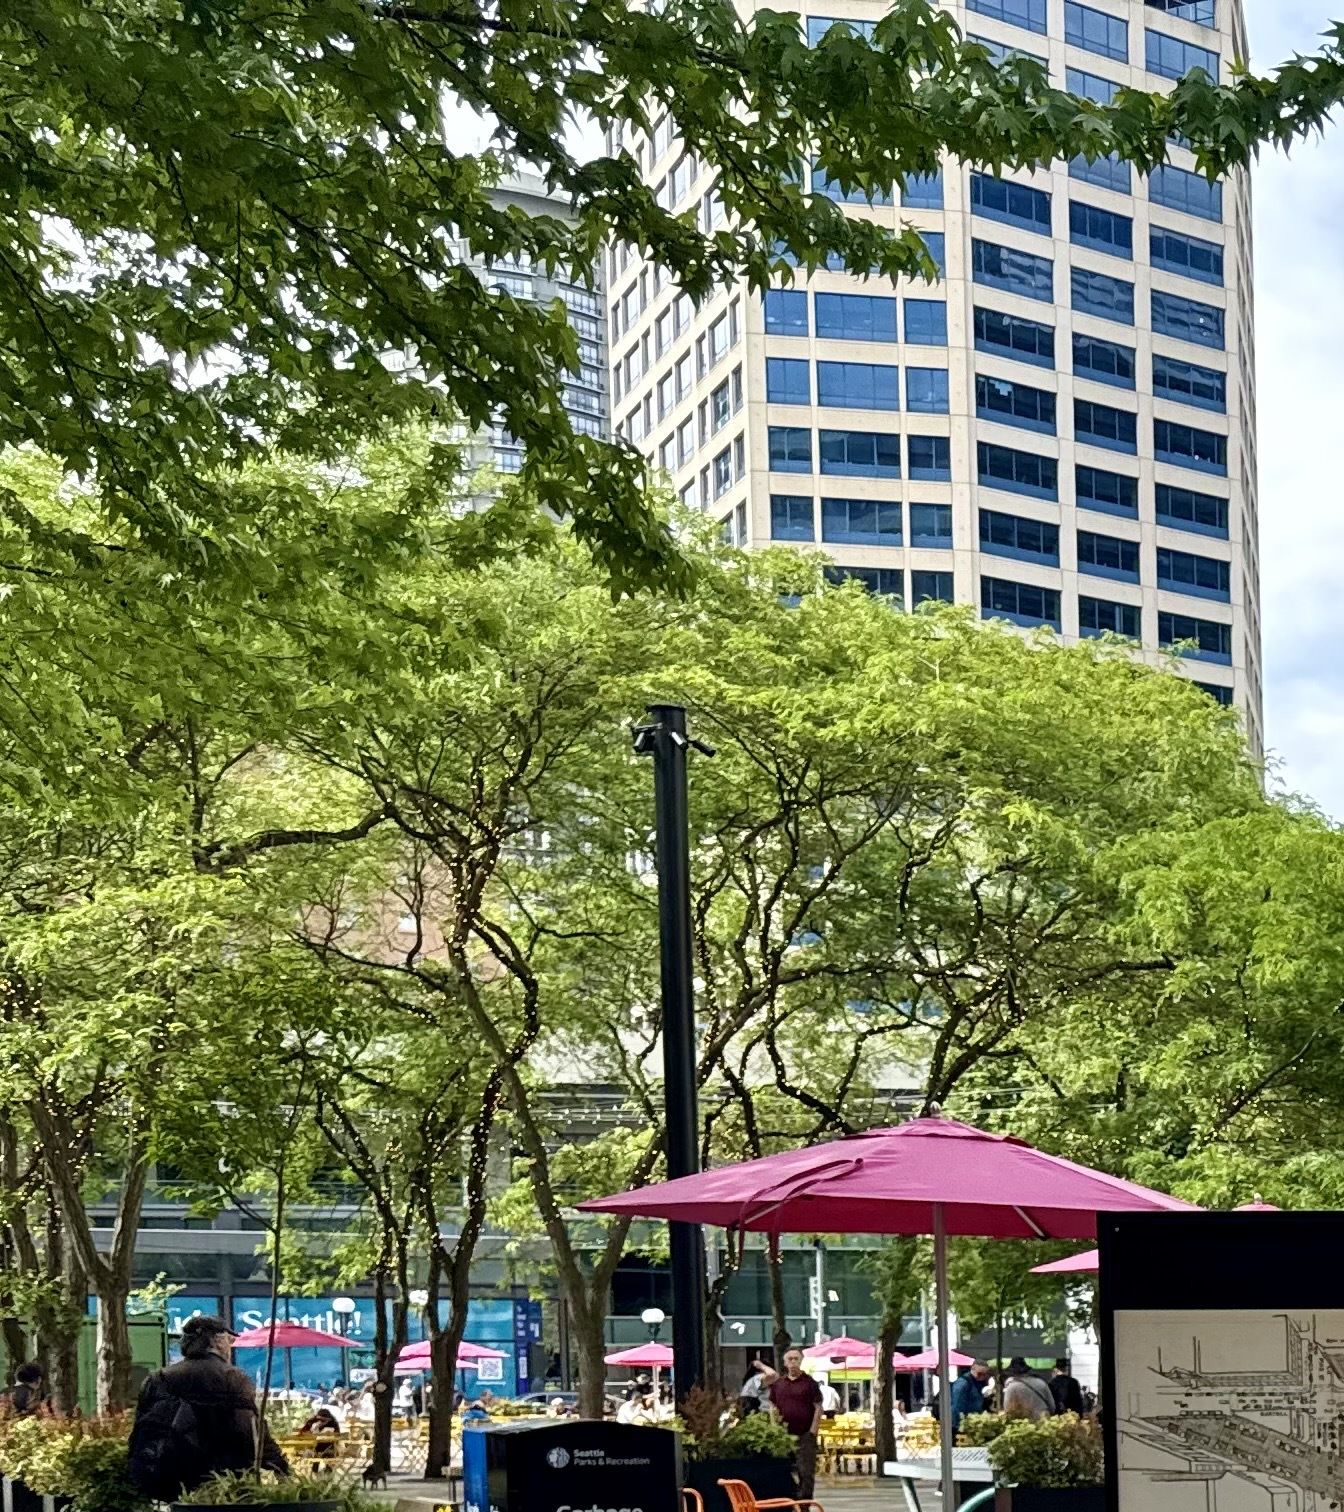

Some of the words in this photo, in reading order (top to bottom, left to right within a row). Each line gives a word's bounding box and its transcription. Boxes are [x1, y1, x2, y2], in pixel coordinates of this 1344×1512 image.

[241, 1310, 361, 1335] Settl!
[573, 1449, 605, 1458] Seattle
[573, 1458, 596, 1466] Parks
[606, 1457, 650, 1465] Recreation
